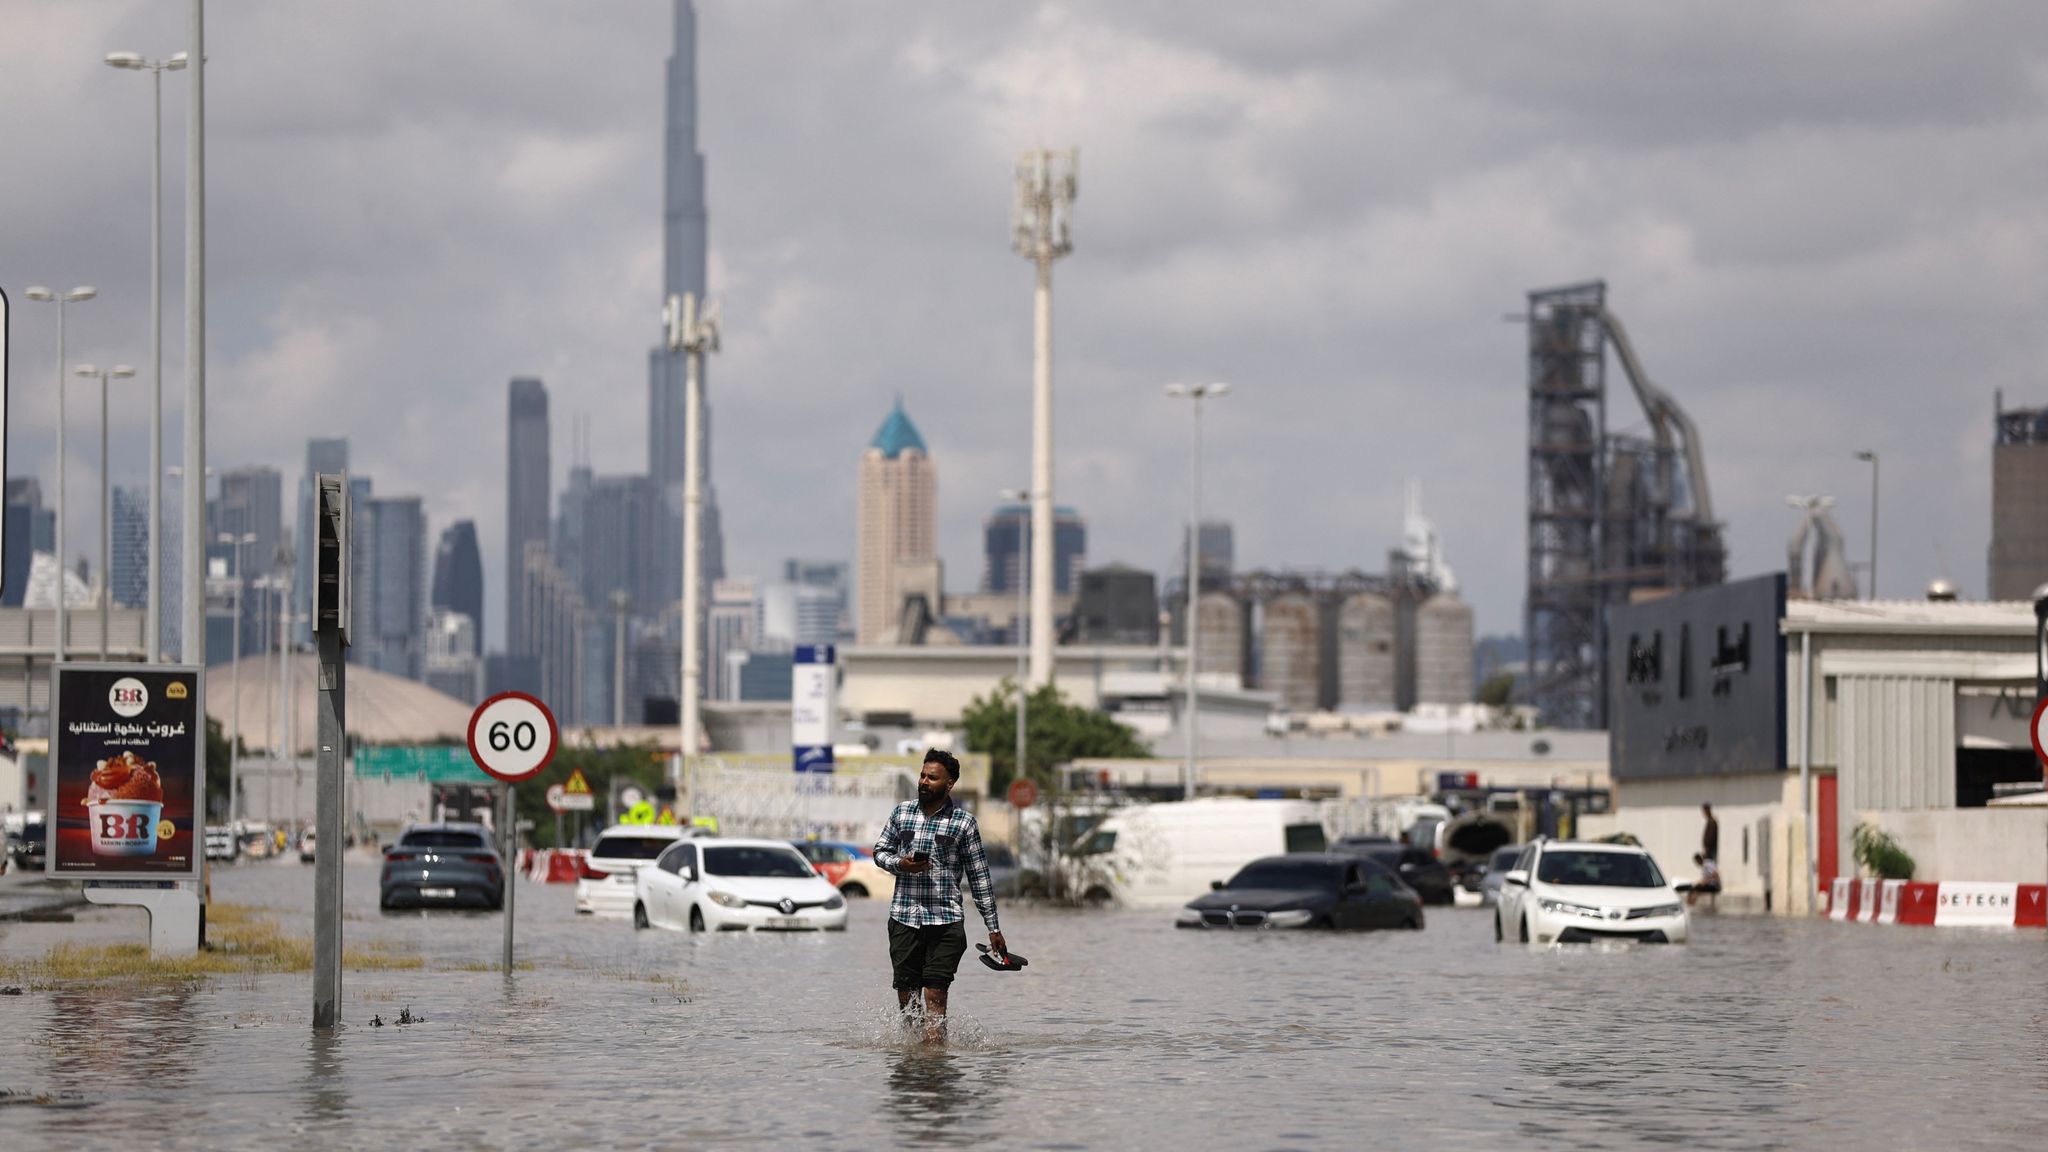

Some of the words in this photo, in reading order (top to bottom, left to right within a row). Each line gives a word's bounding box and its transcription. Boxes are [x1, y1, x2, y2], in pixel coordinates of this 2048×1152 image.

[114, 688, 143, 703] BR
[489, 721, 536, 751] 60
[100, 813, 150, 839] BR
